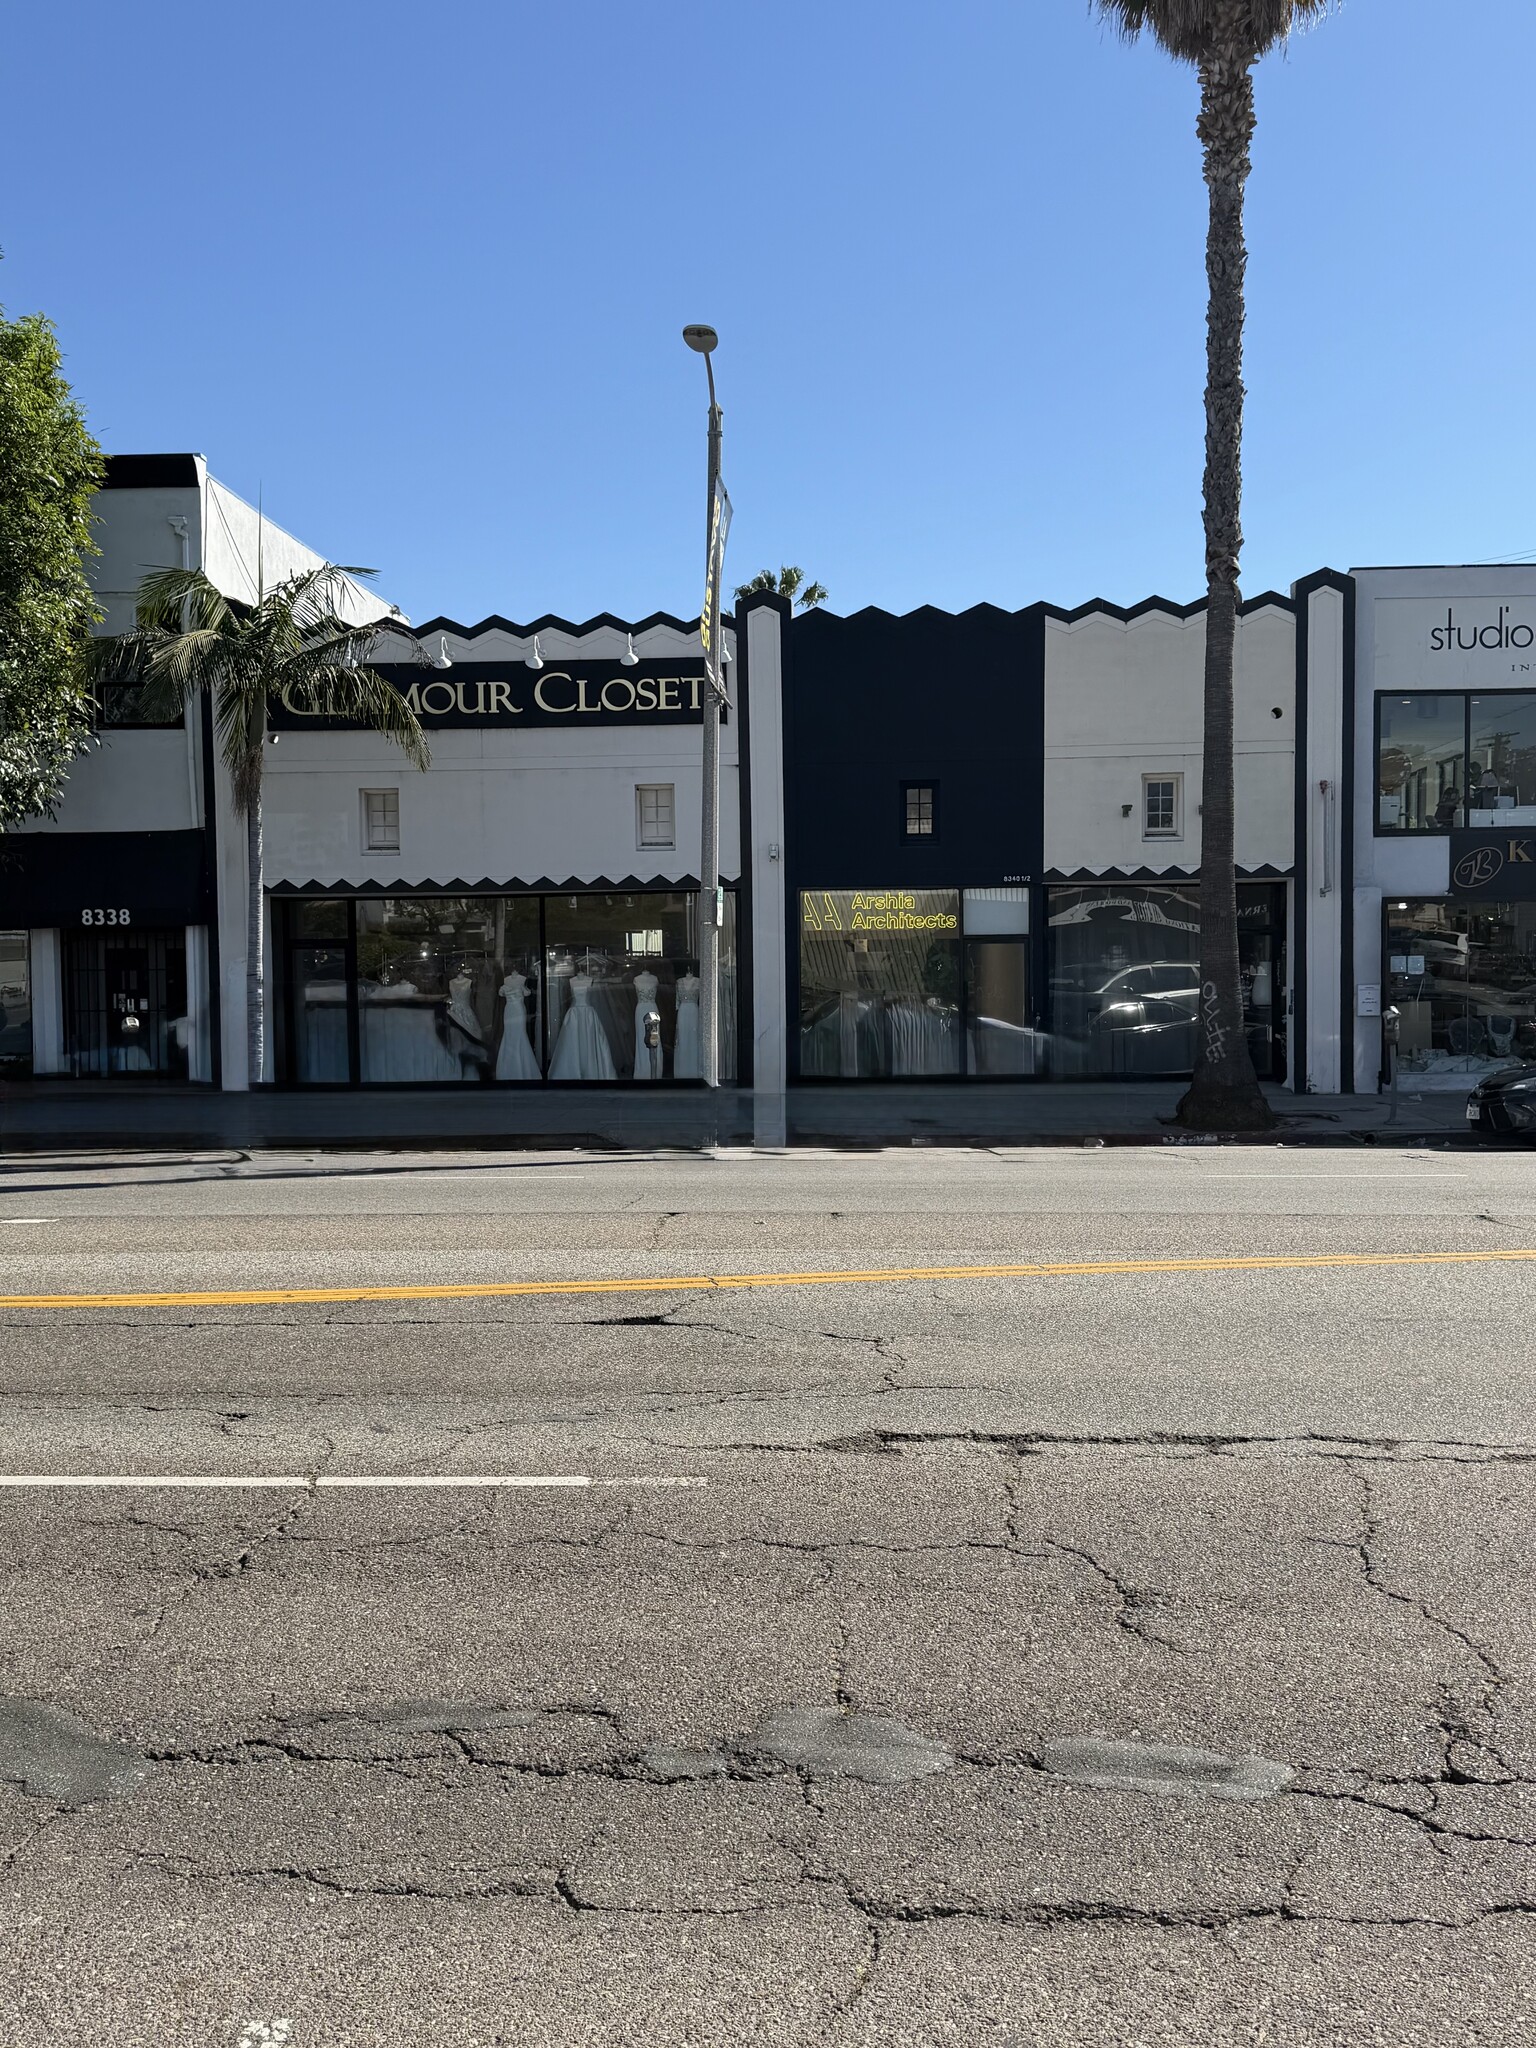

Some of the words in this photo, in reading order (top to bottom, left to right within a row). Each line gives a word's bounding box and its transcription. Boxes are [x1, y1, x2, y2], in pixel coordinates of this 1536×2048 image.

[1430, 606, 1534, 651] studio
[1511, 663, 1536, 672] IN
[282, 680, 523, 715] GLMOUR
[534, 672, 705, 713] CLOSET
[852, 892, 915, 909] Arshia
[81, 908, 131, 926] 8338
[852, 911, 957, 929] Architects
